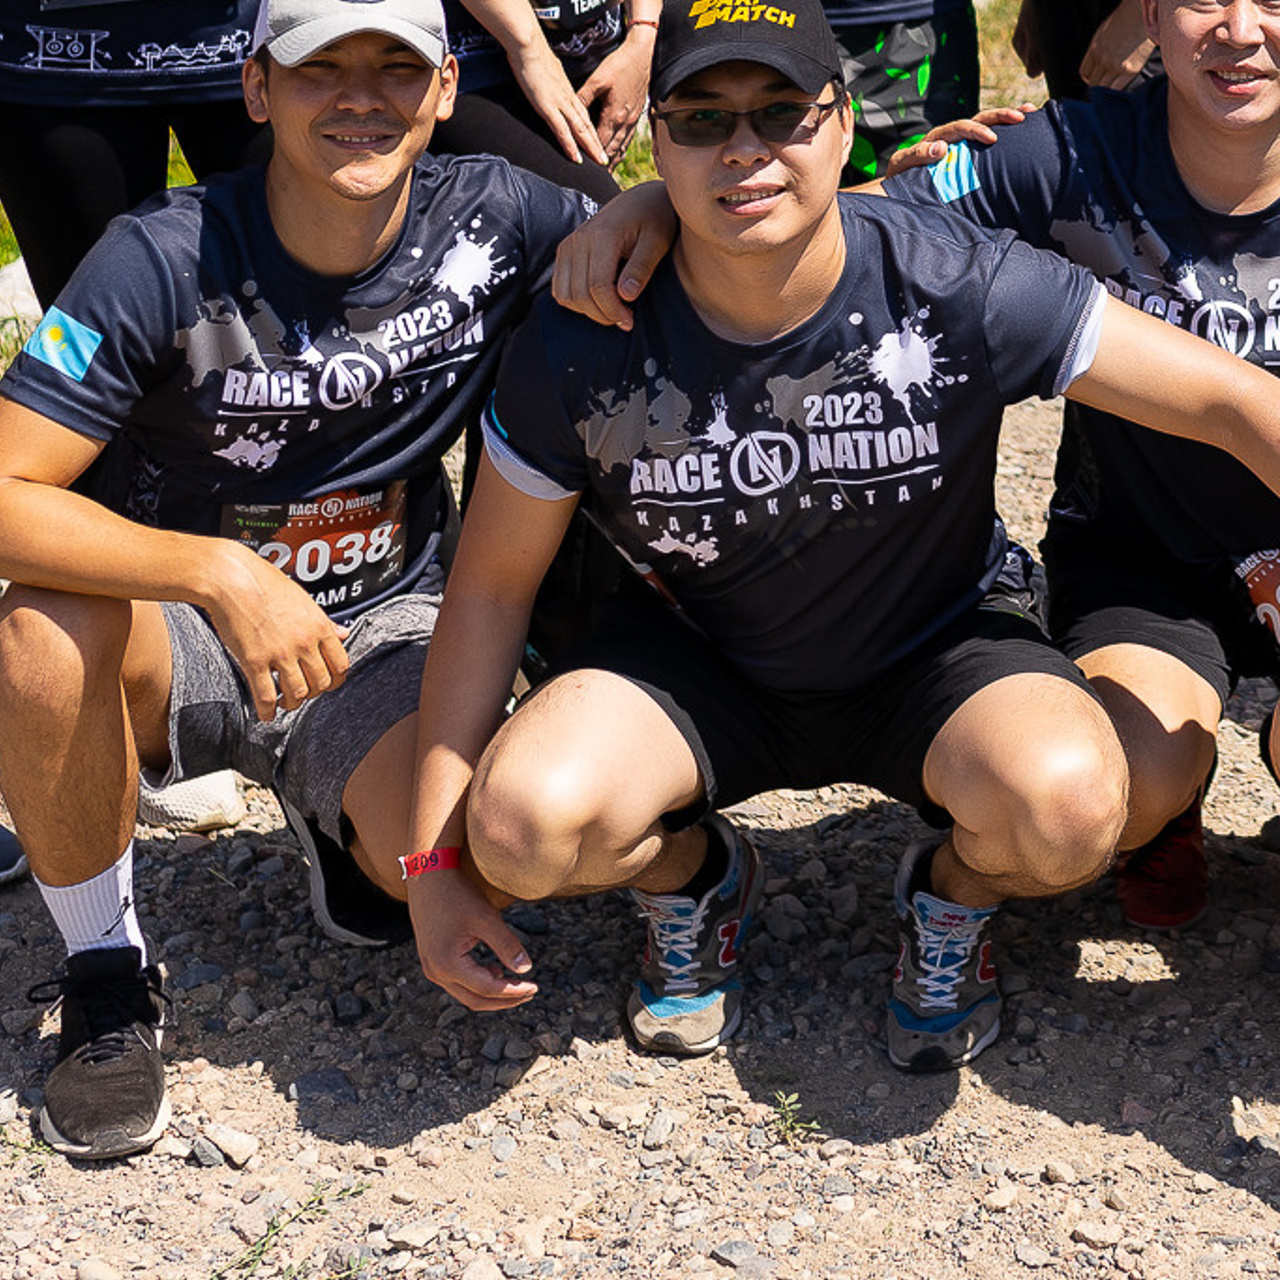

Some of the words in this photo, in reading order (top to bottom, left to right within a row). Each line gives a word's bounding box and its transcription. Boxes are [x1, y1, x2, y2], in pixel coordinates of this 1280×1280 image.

[694, 4, 797, 30] MATCH
[378, 299, 454, 349] 2023
[222, 368, 311, 408] RACE
[803, 391, 883, 428] 2023
[630, 452, 722, 496] RACE
[808, 422, 940, 473] NATION
[288, 503, 319, 517] RACE
[636, 475, 943, 532] KAZAKHSTAN
[257, 520, 394, 582] 2038
[351, 580, 364, 597] 5
